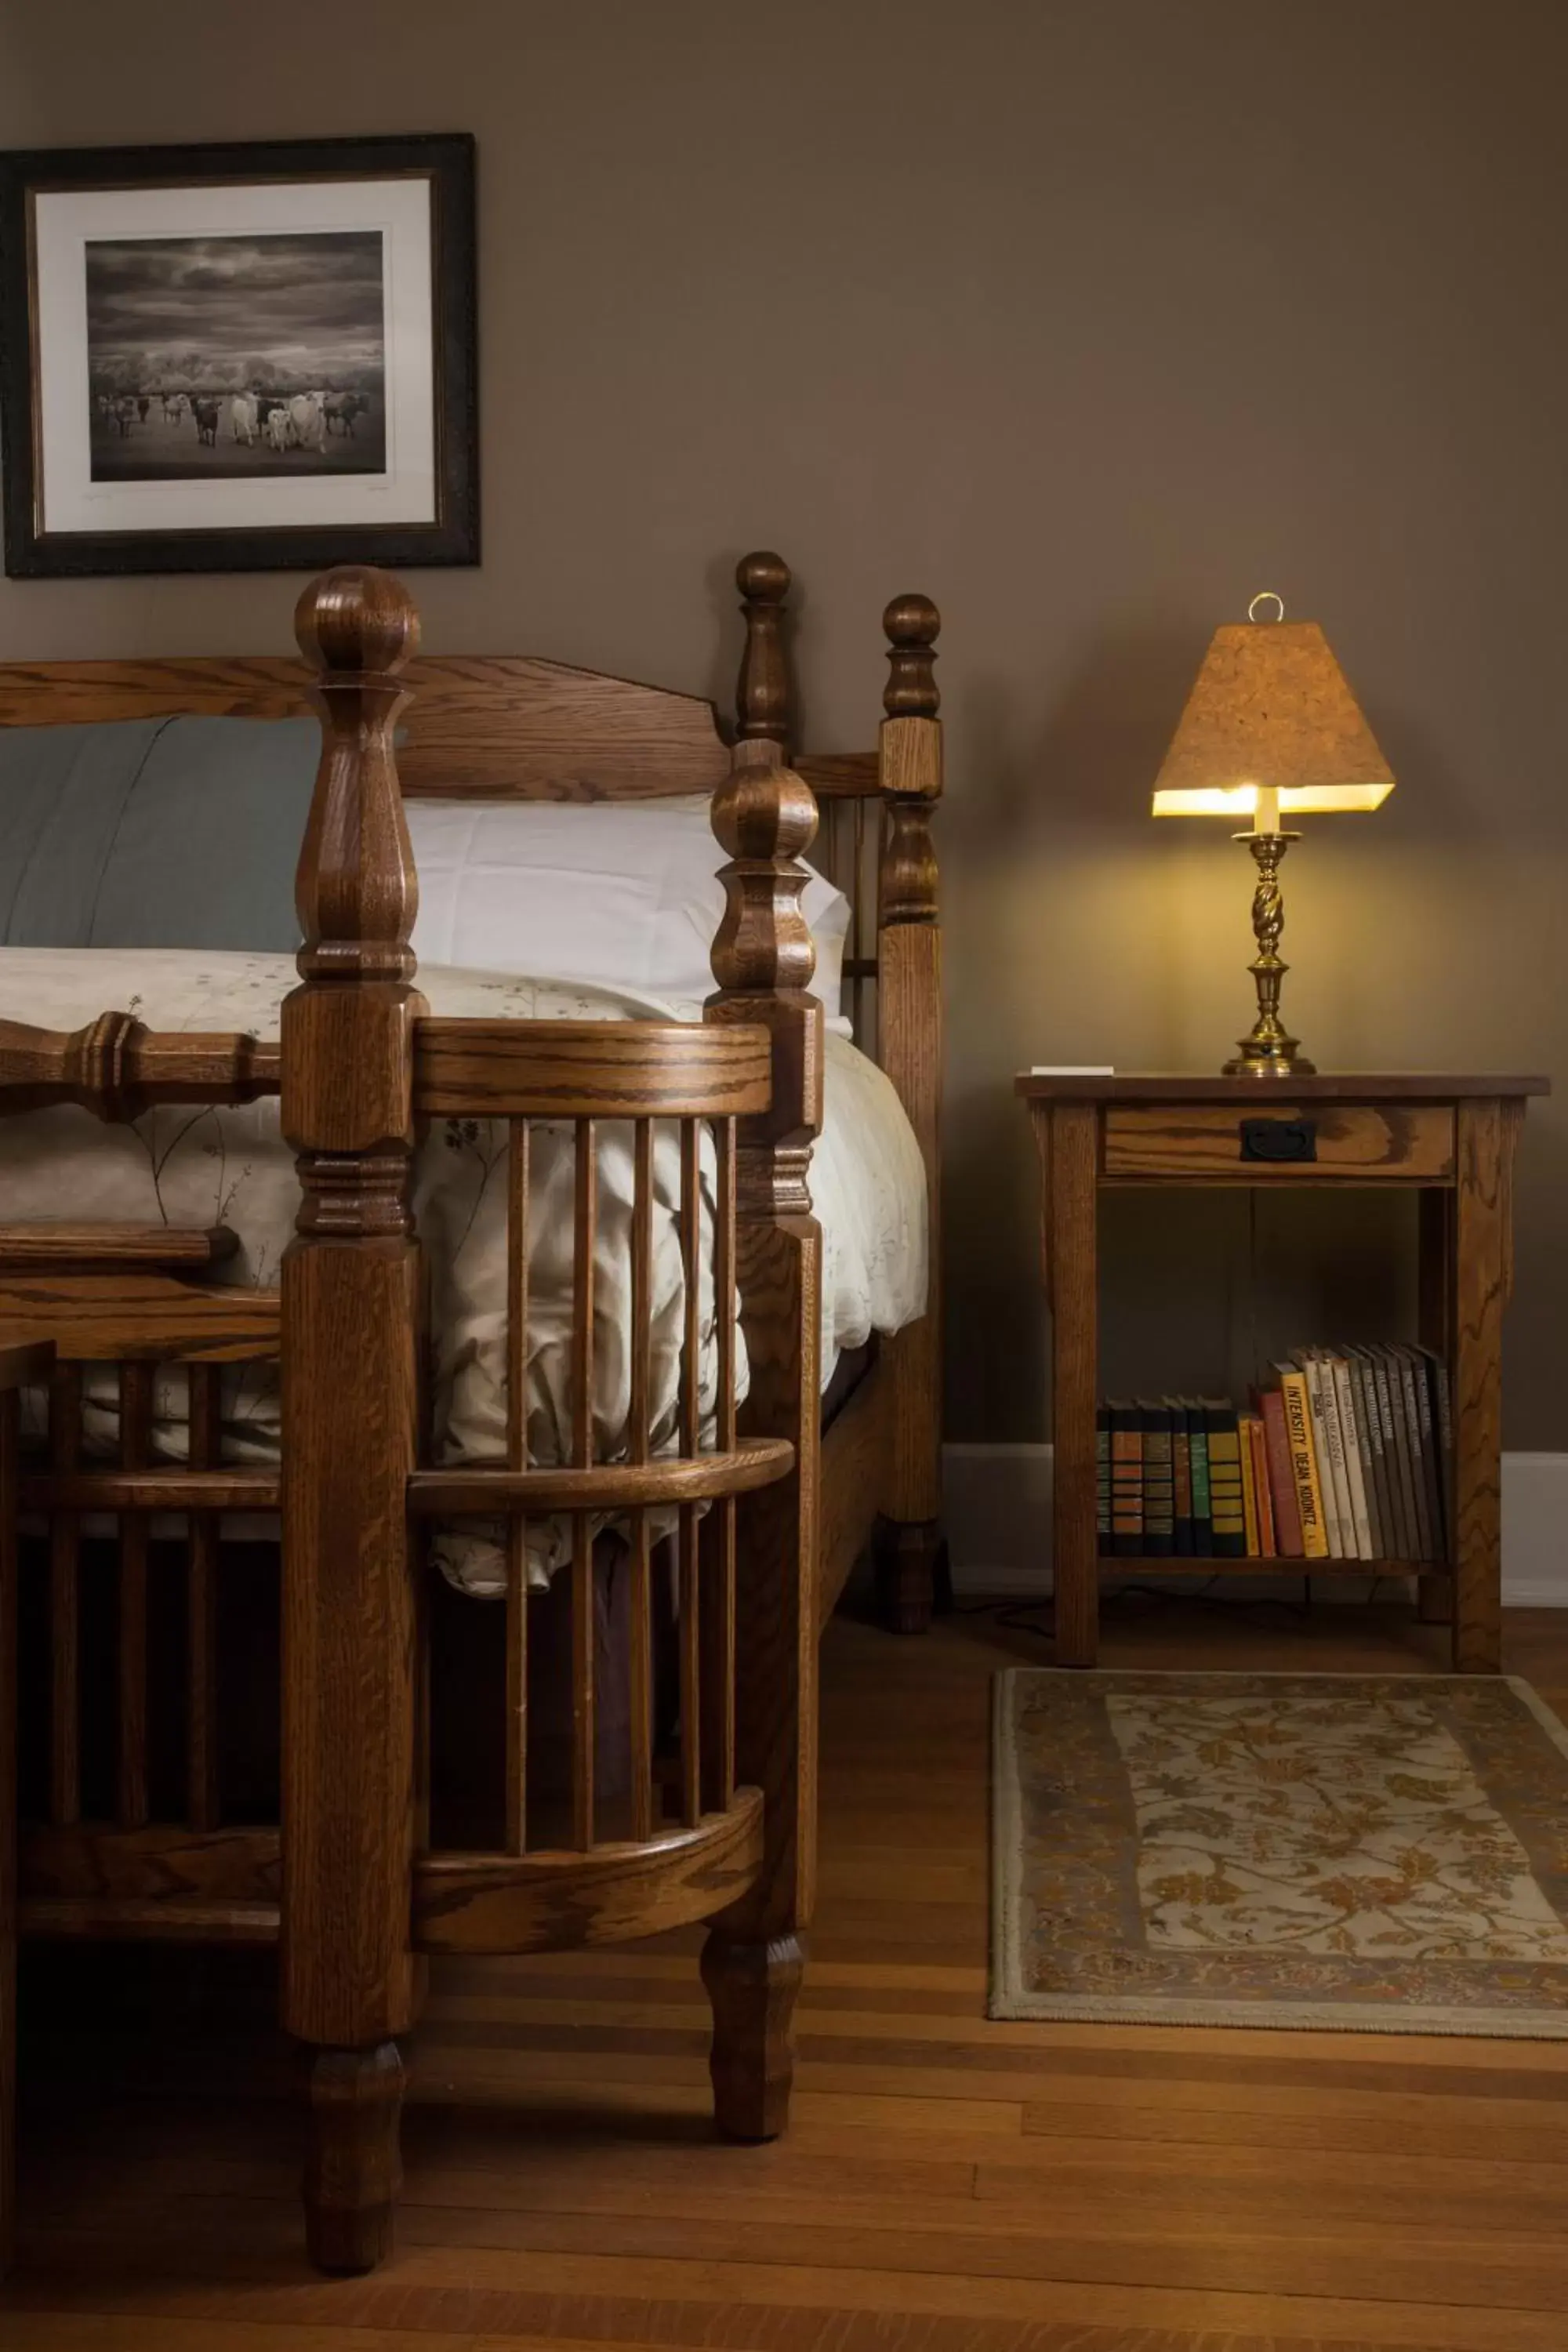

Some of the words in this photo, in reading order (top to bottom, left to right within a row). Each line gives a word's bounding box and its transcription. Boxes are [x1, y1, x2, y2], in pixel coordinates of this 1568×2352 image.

[1287, 1385, 1307, 1446] INTENSITY
[1295, 1452, 1311, 1480] DEAN
[1300, 1485, 1317, 1526] KOONTZ
